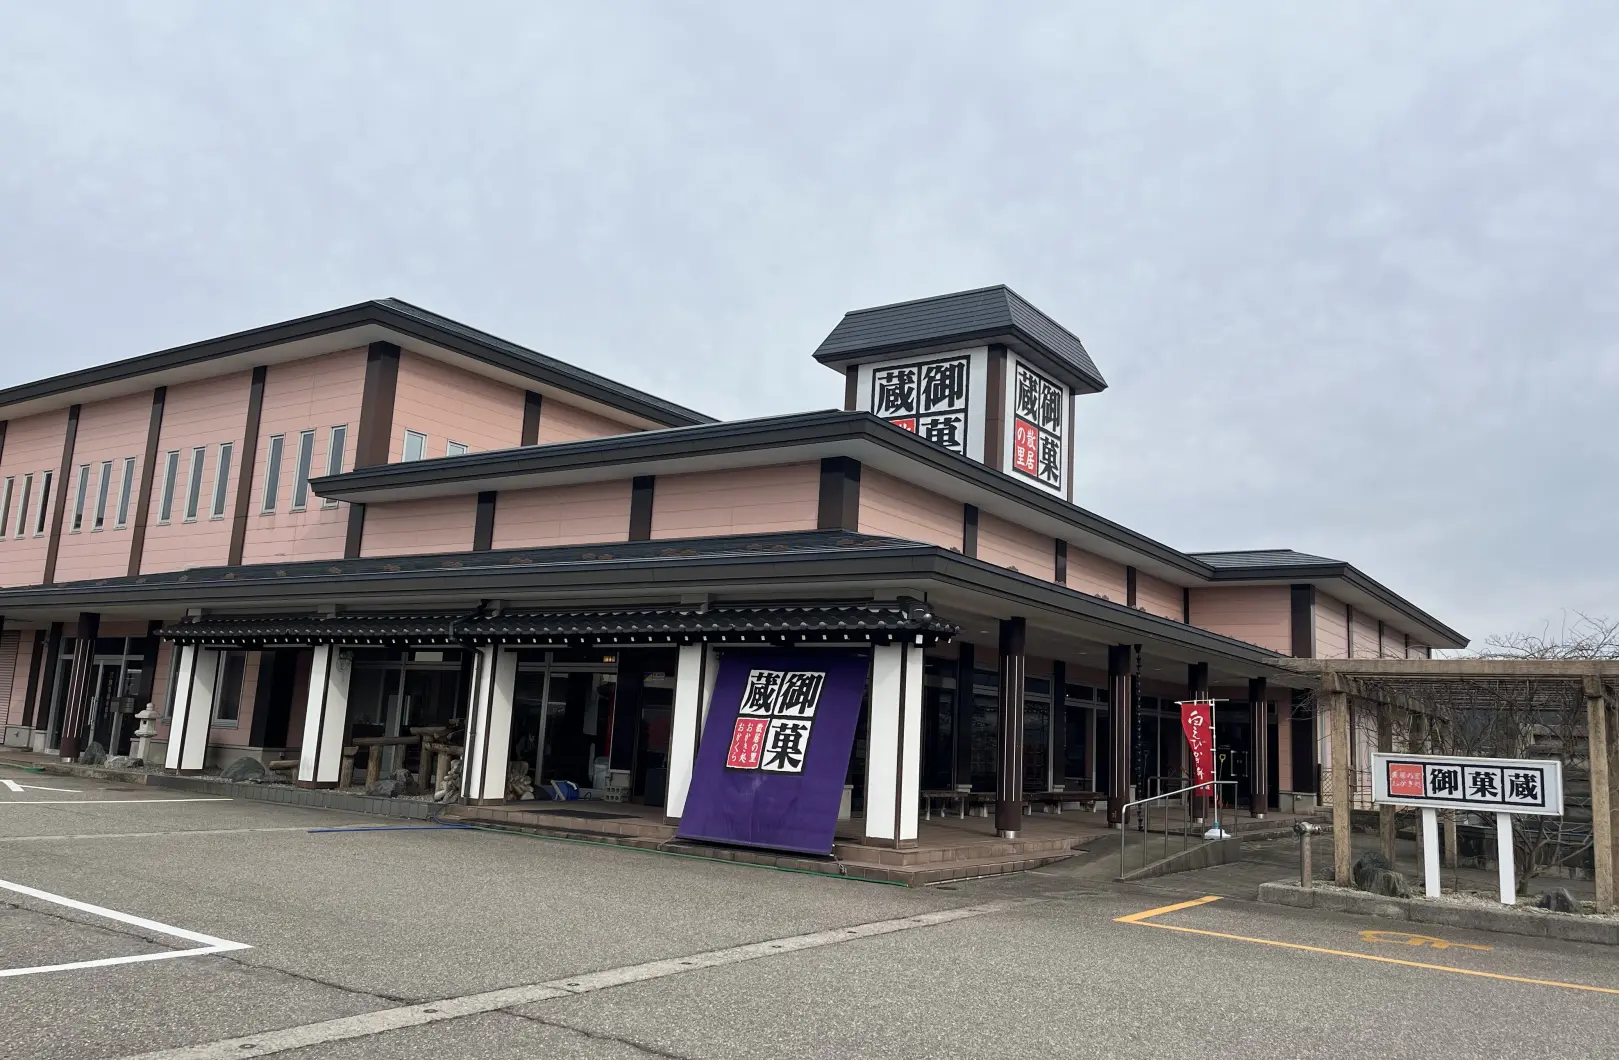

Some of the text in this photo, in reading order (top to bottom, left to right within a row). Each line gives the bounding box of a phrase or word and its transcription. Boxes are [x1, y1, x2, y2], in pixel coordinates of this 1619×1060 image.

[876, 369, 916, 415] 蔵
[1017, 370, 1038, 422] 蔵
[1016, 426, 1026, 467] の里
[1040, 381, 1061, 482] 御菓
[741, 672, 780, 713] 蔵
[764, 673, 824, 770] 御菓
[1430, 768, 1538, 801] 御菓蔵
